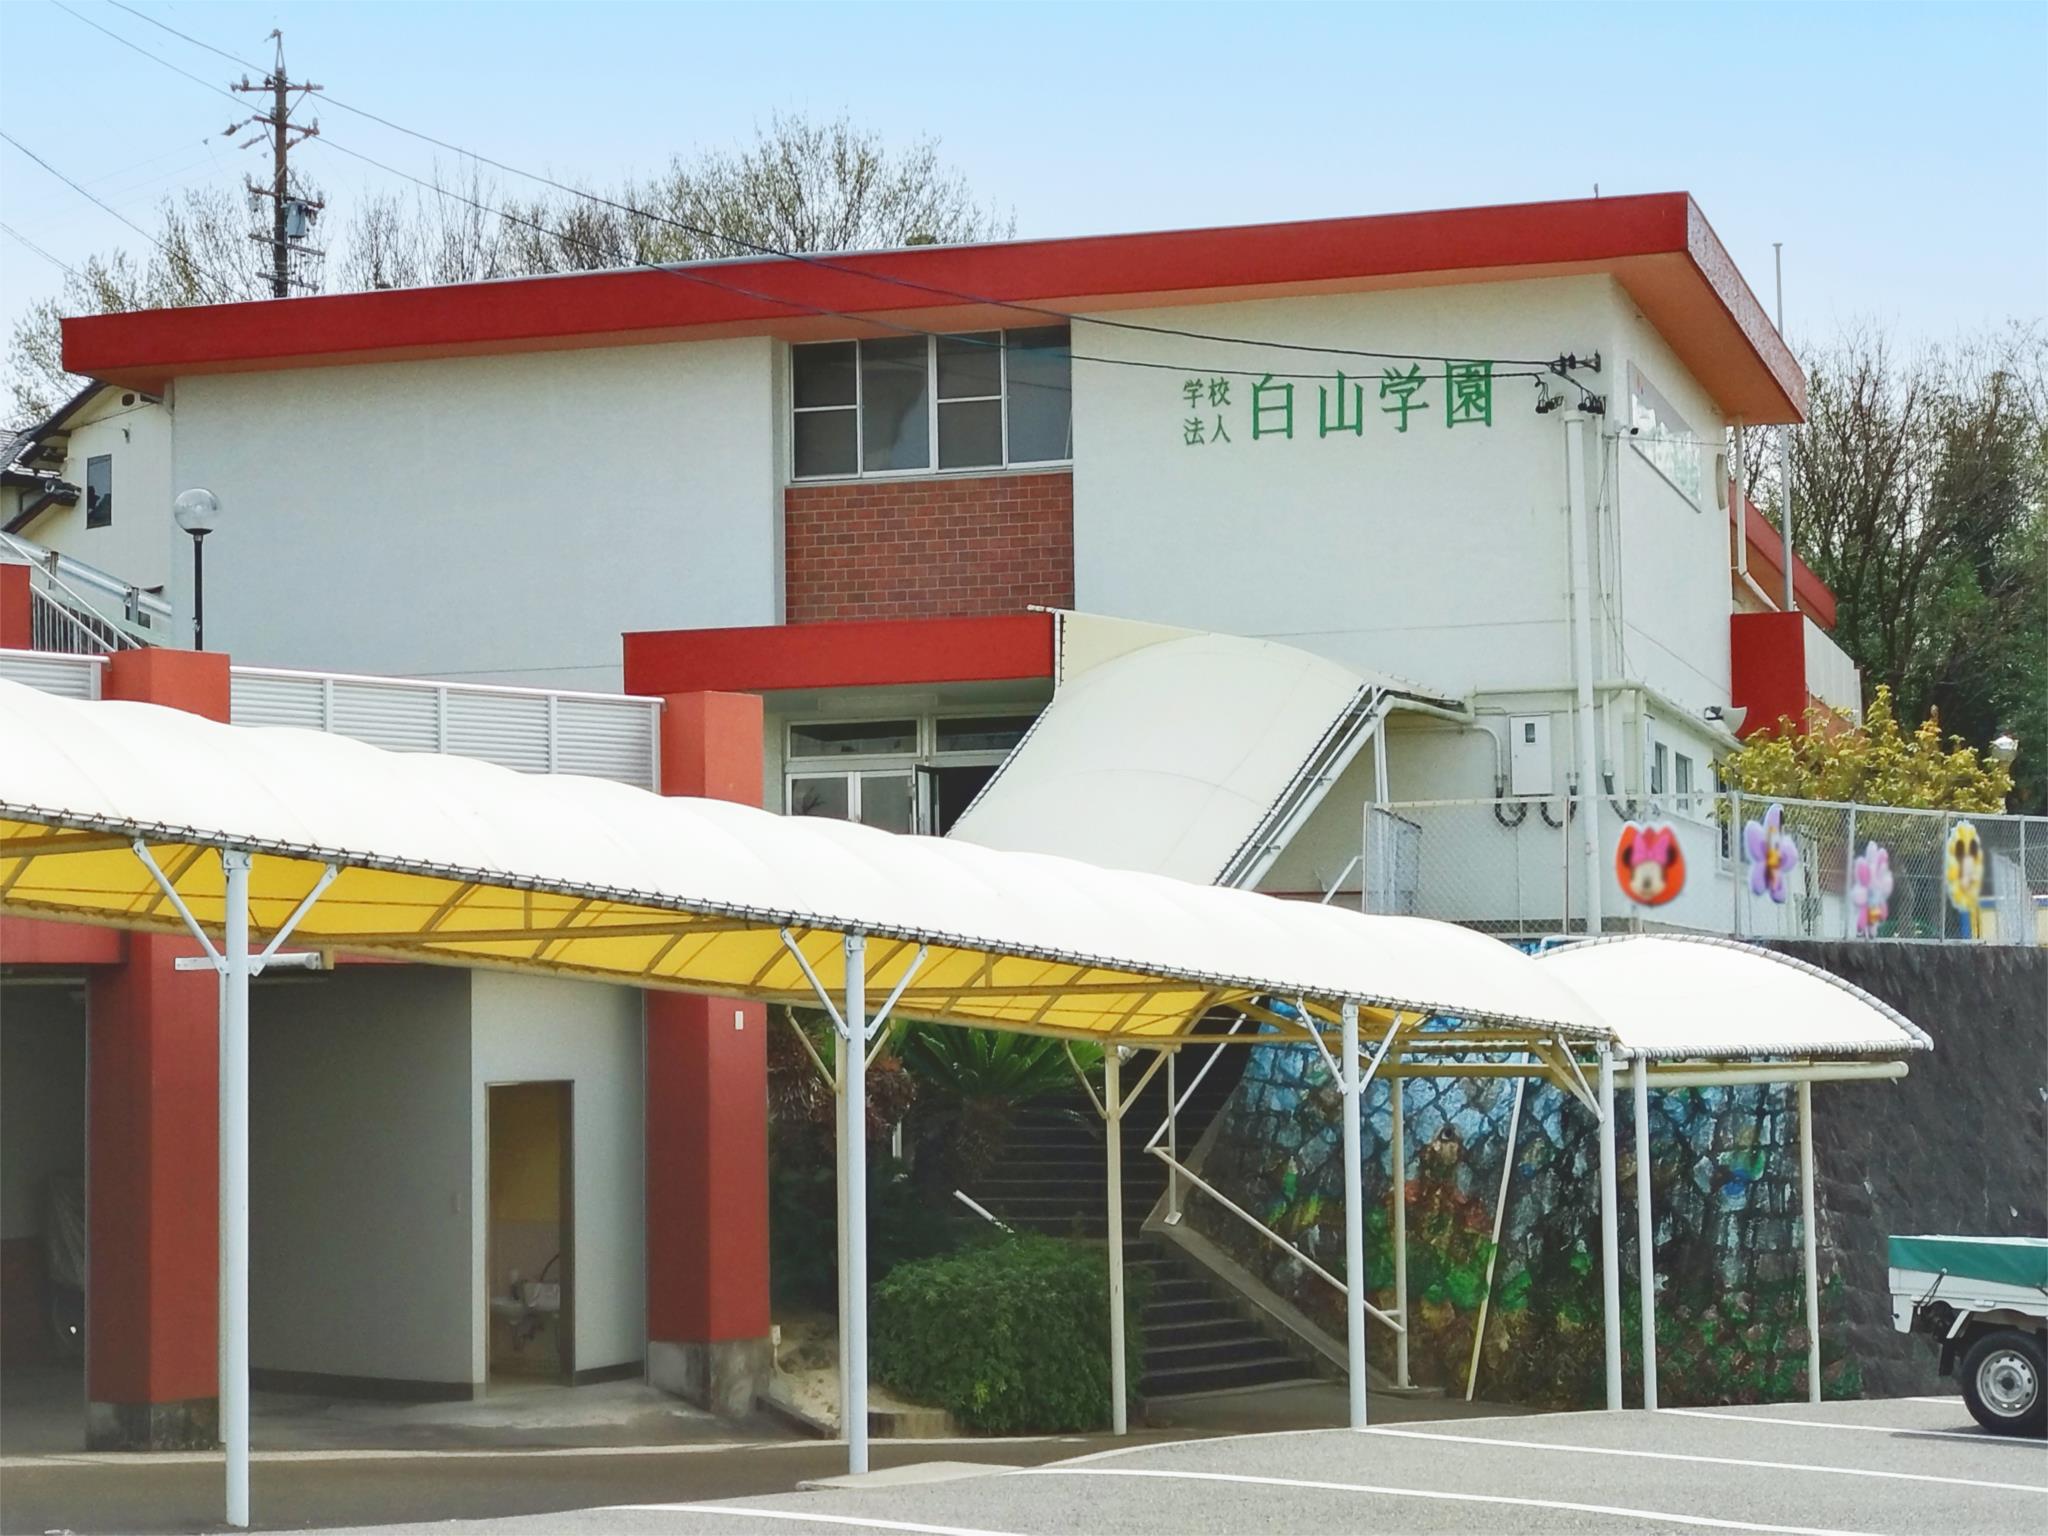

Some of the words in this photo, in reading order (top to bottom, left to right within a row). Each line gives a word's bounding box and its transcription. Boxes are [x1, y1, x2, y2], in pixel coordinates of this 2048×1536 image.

[1183, 376, 1231, 408] 学校
[1252, 360, 1493, 440] 白山学園
[1183, 415, 1231, 445] 法人
